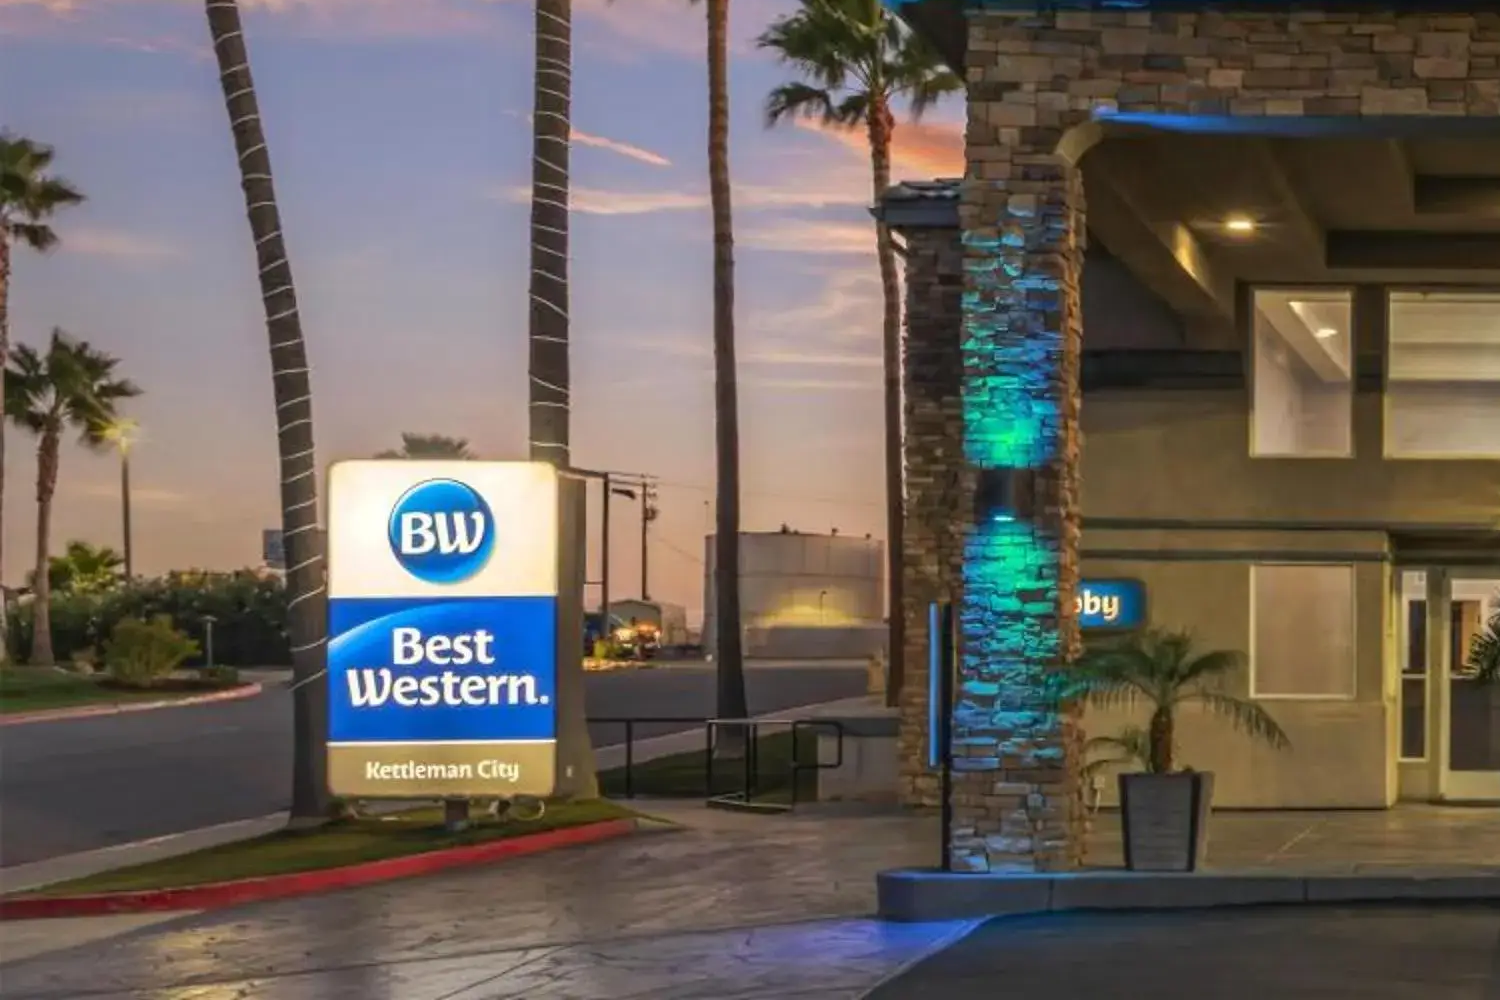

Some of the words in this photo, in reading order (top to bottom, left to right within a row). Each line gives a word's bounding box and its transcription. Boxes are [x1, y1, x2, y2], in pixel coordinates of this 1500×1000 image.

[401, 511, 485, 555] BW
[392, 627, 495, 665] Best
[365, 761, 473, 780] Kettleman
[477, 760, 520, 782] City
